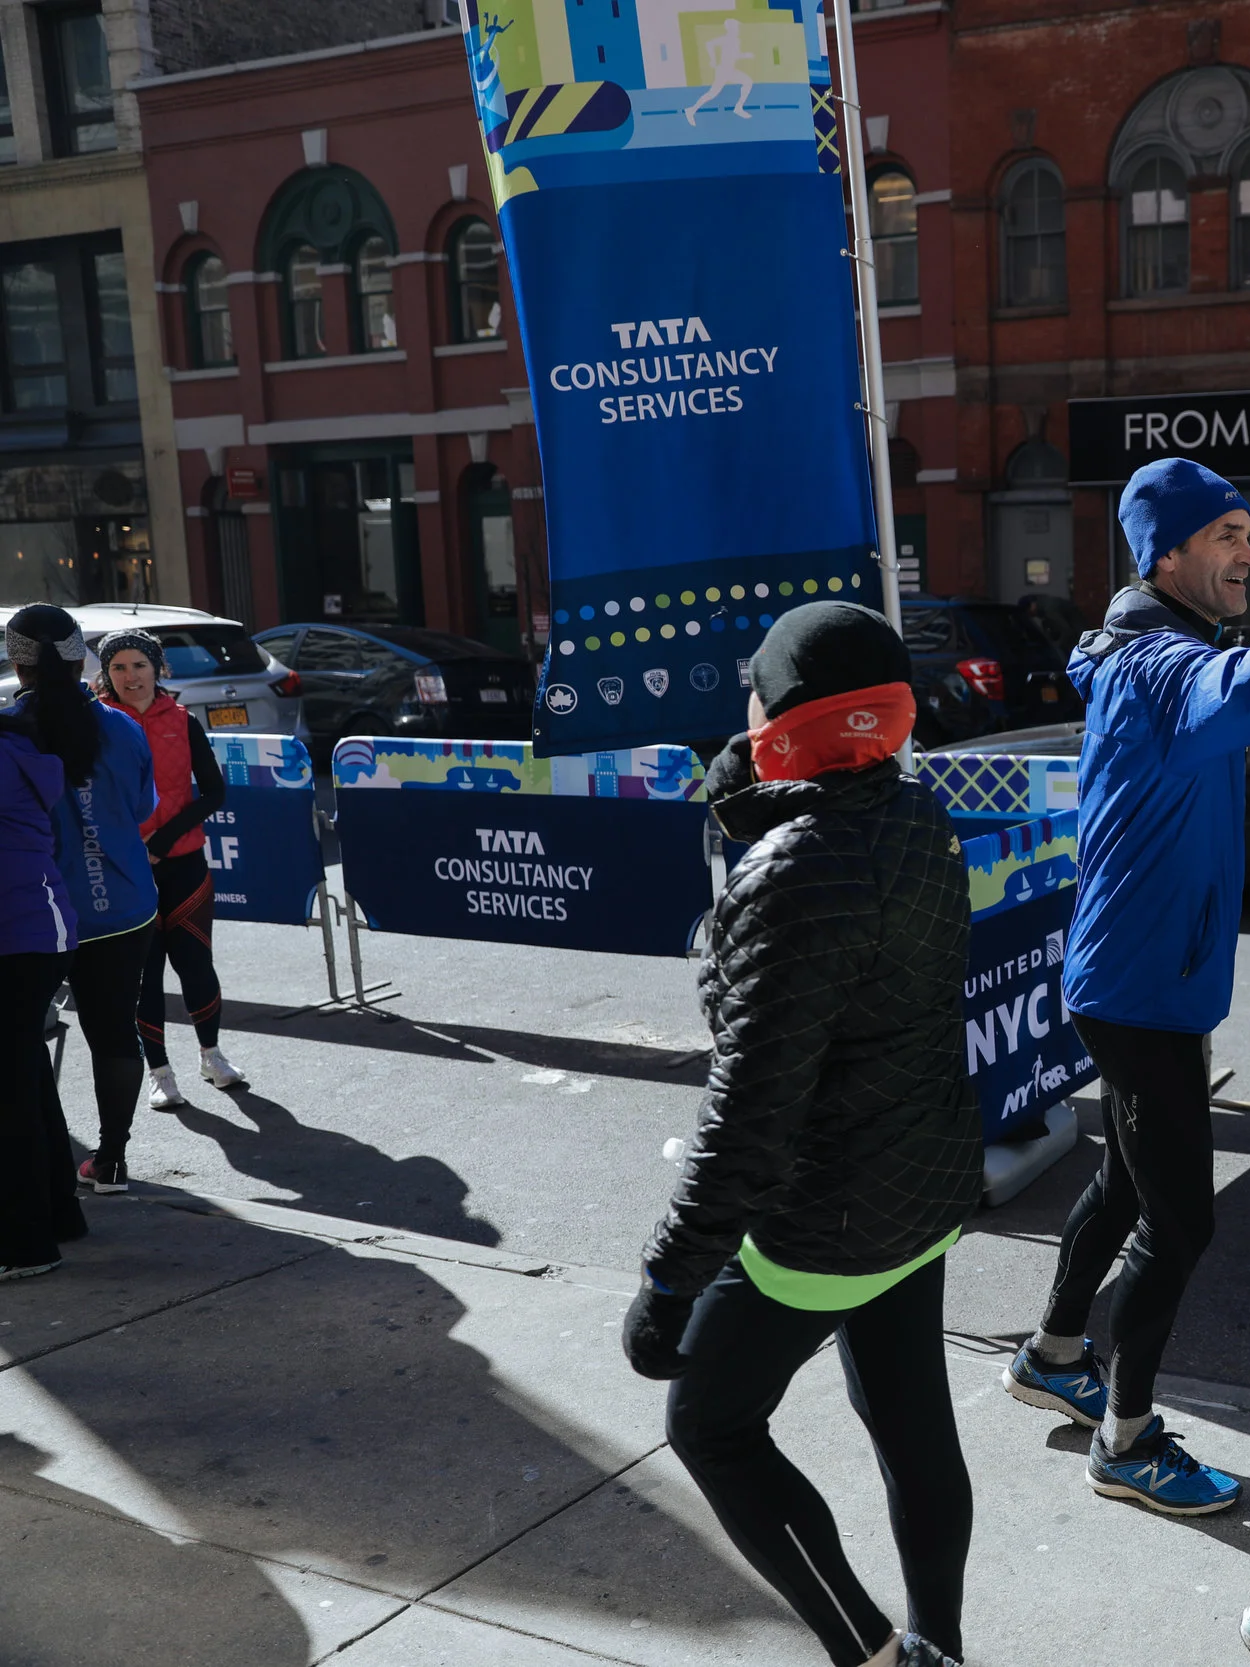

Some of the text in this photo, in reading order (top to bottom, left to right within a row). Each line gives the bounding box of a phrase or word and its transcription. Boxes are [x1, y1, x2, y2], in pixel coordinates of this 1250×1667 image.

[611, 317, 711, 349] TATA
[550, 347, 778, 391] CONSULTANCY
[600, 386, 743, 424] SERVICES
[1124, 409, 1249, 451] FROM
[77, 776, 109, 912] new balance
[203, 836, 239, 870] LF
[475, 828, 546, 855] TATA
[434, 857, 593, 890] CONSULTANCY
[466, 890, 568, 921] SERVICES
[964, 949, 1042, 998] UNITED
[966, 983, 1050, 1076] NYC
[1075, 1055, 1094, 1075] RUN
